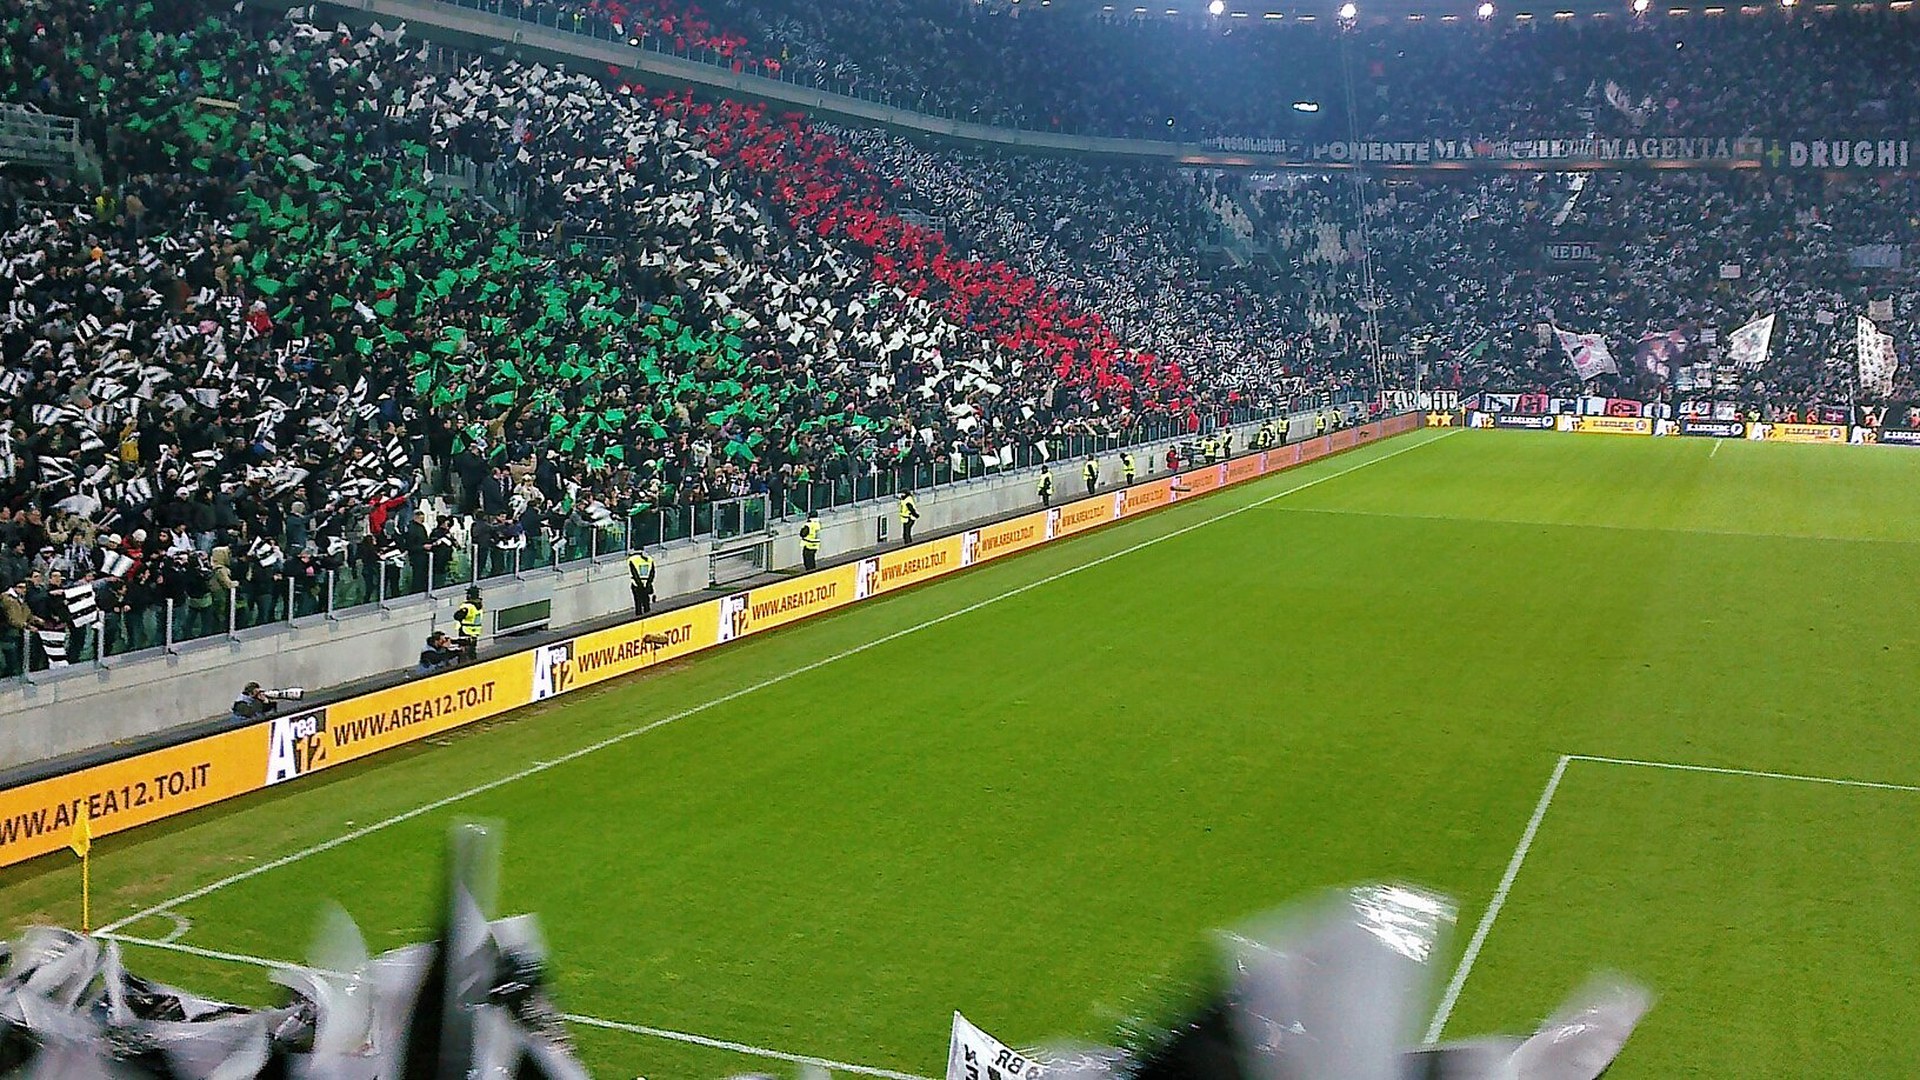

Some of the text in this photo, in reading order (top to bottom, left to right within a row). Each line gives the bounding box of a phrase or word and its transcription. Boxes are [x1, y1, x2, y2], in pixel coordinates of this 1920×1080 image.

[1314, 141, 1430, 161] PONENTE
[1435, 137, 1569, 160] MACHE
[1601, 137, 1730, 160] MAGENTA
[1790, 139, 1909, 168] DRUGHI
[752, 582, 837, 621] WWW.AREA12.TO.IT
[577, 623, 692, 673] WWW.AREATO.IT
[551, 659, 574, 692] 12
[334, 681, 496, 747] WWW.AREA12.TO.IT
[266, 714, 327, 785] Area 12
